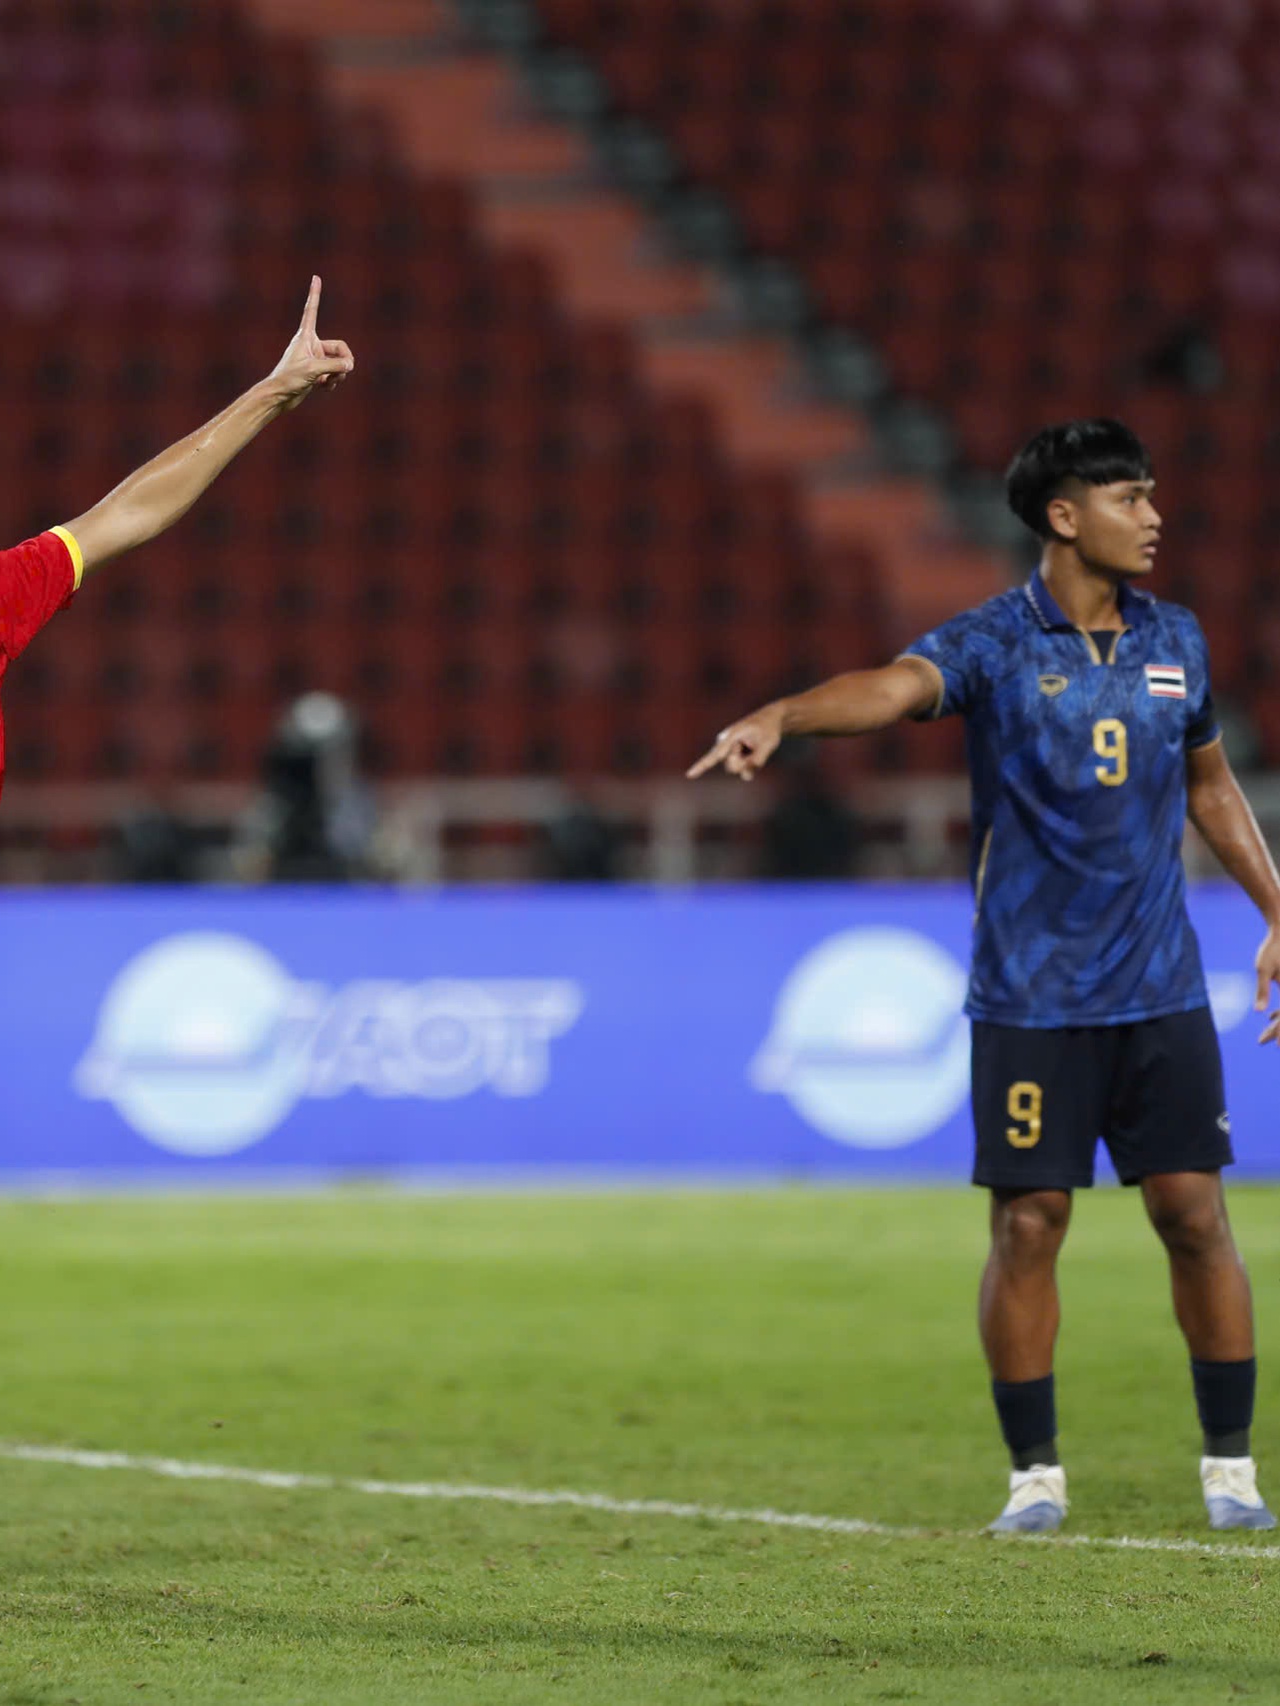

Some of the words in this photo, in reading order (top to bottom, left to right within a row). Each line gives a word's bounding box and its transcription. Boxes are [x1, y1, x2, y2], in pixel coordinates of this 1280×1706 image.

[1093, 717, 1128, 787] 9
[300, 978, 583, 1099] AOT
[1006, 1081, 1043, 1149] 9
